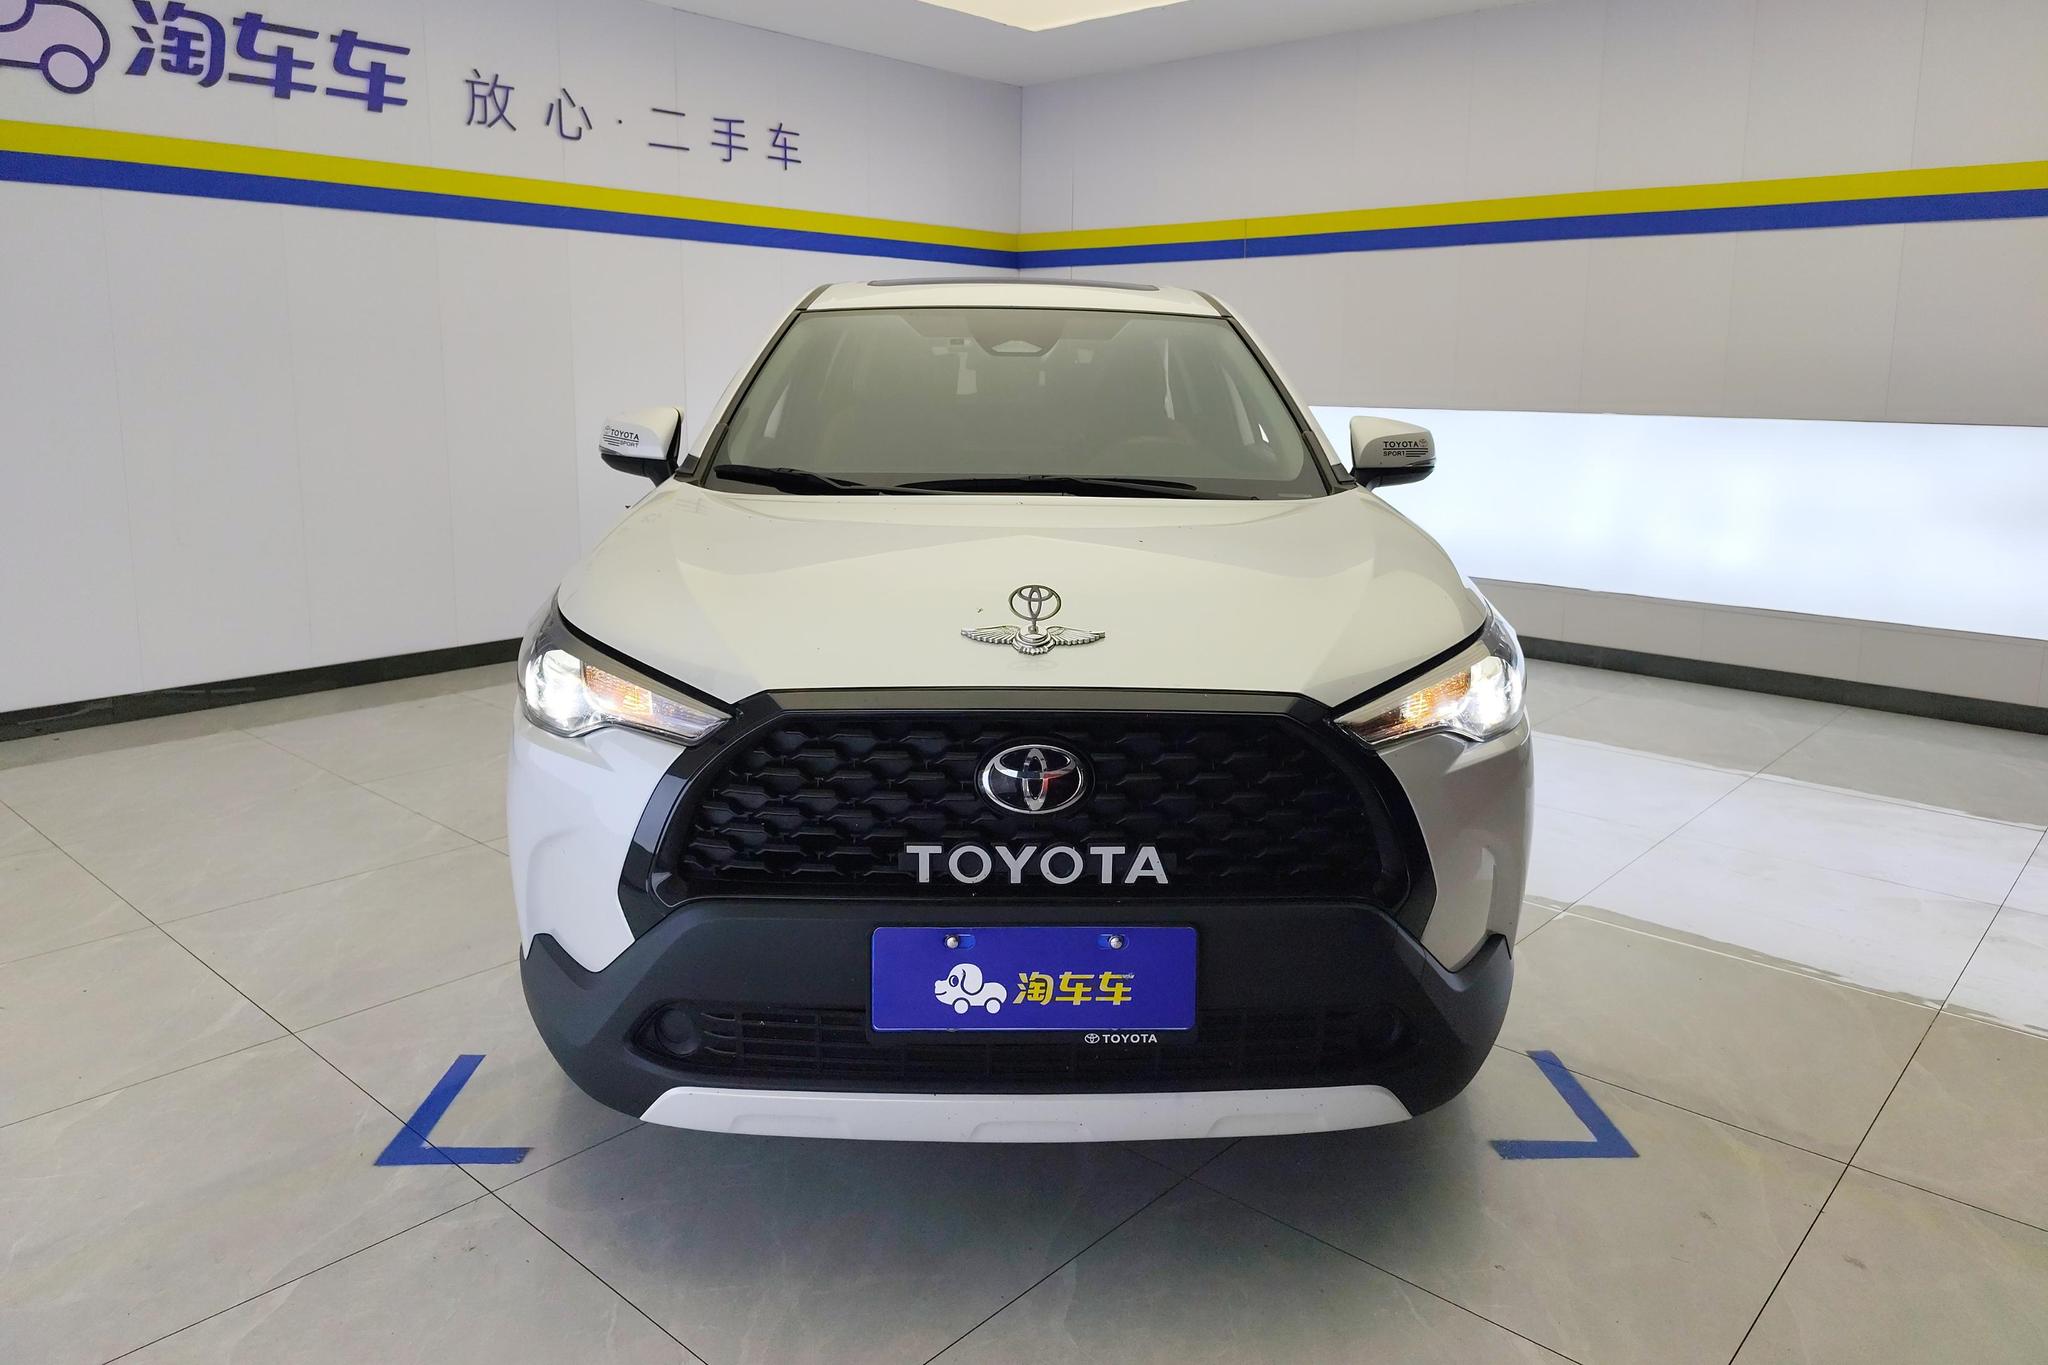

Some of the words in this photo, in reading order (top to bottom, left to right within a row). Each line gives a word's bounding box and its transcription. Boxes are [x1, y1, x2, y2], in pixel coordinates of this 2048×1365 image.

[126, 0, 411, 113] 淘车车
[610, 428, 640, 441] TOYOTA
[620, 440, 639, 448] SPORT
[1383, 440, 1420, 448] TOYOTA
[905, 844, 1169, 885] TOYOTA
[1012, 971, 1135, 1006] 淘车车
[1102, 1034, 1158, 1044] TOYOTA
